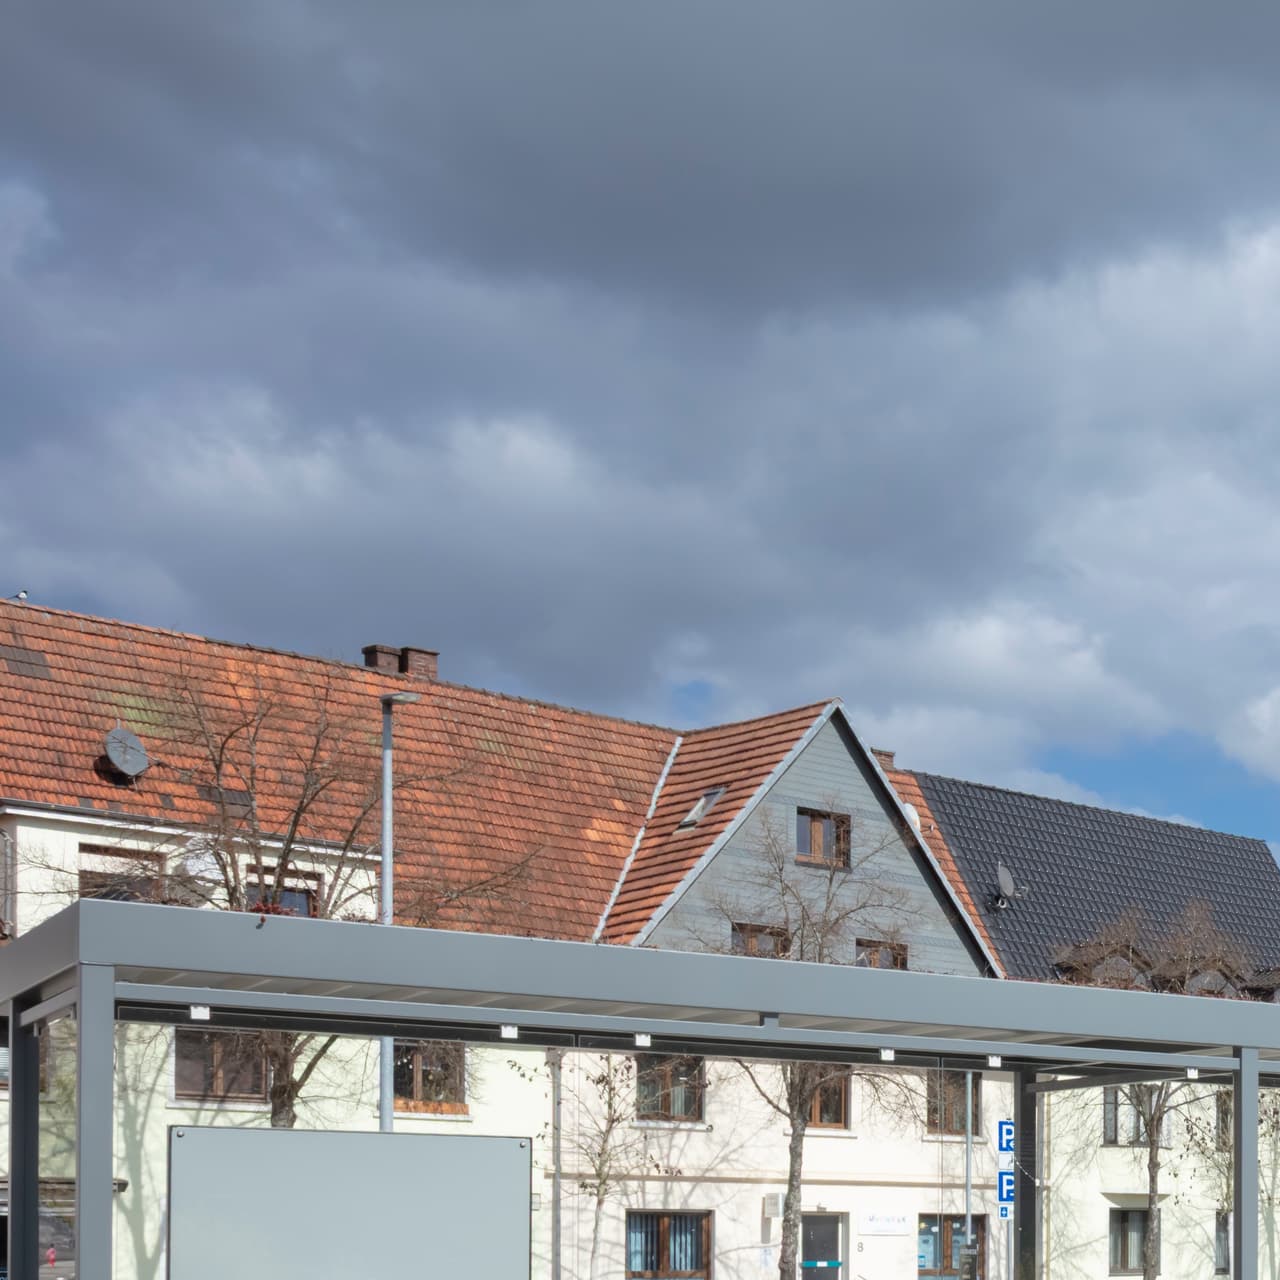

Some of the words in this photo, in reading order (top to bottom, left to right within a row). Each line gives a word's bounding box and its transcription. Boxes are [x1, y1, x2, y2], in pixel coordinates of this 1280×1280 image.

[1002, 1124, 1014, 1148] P
[1002, 1175, 1014, 1199] P
[857, 1241, 864, 1253] 8
